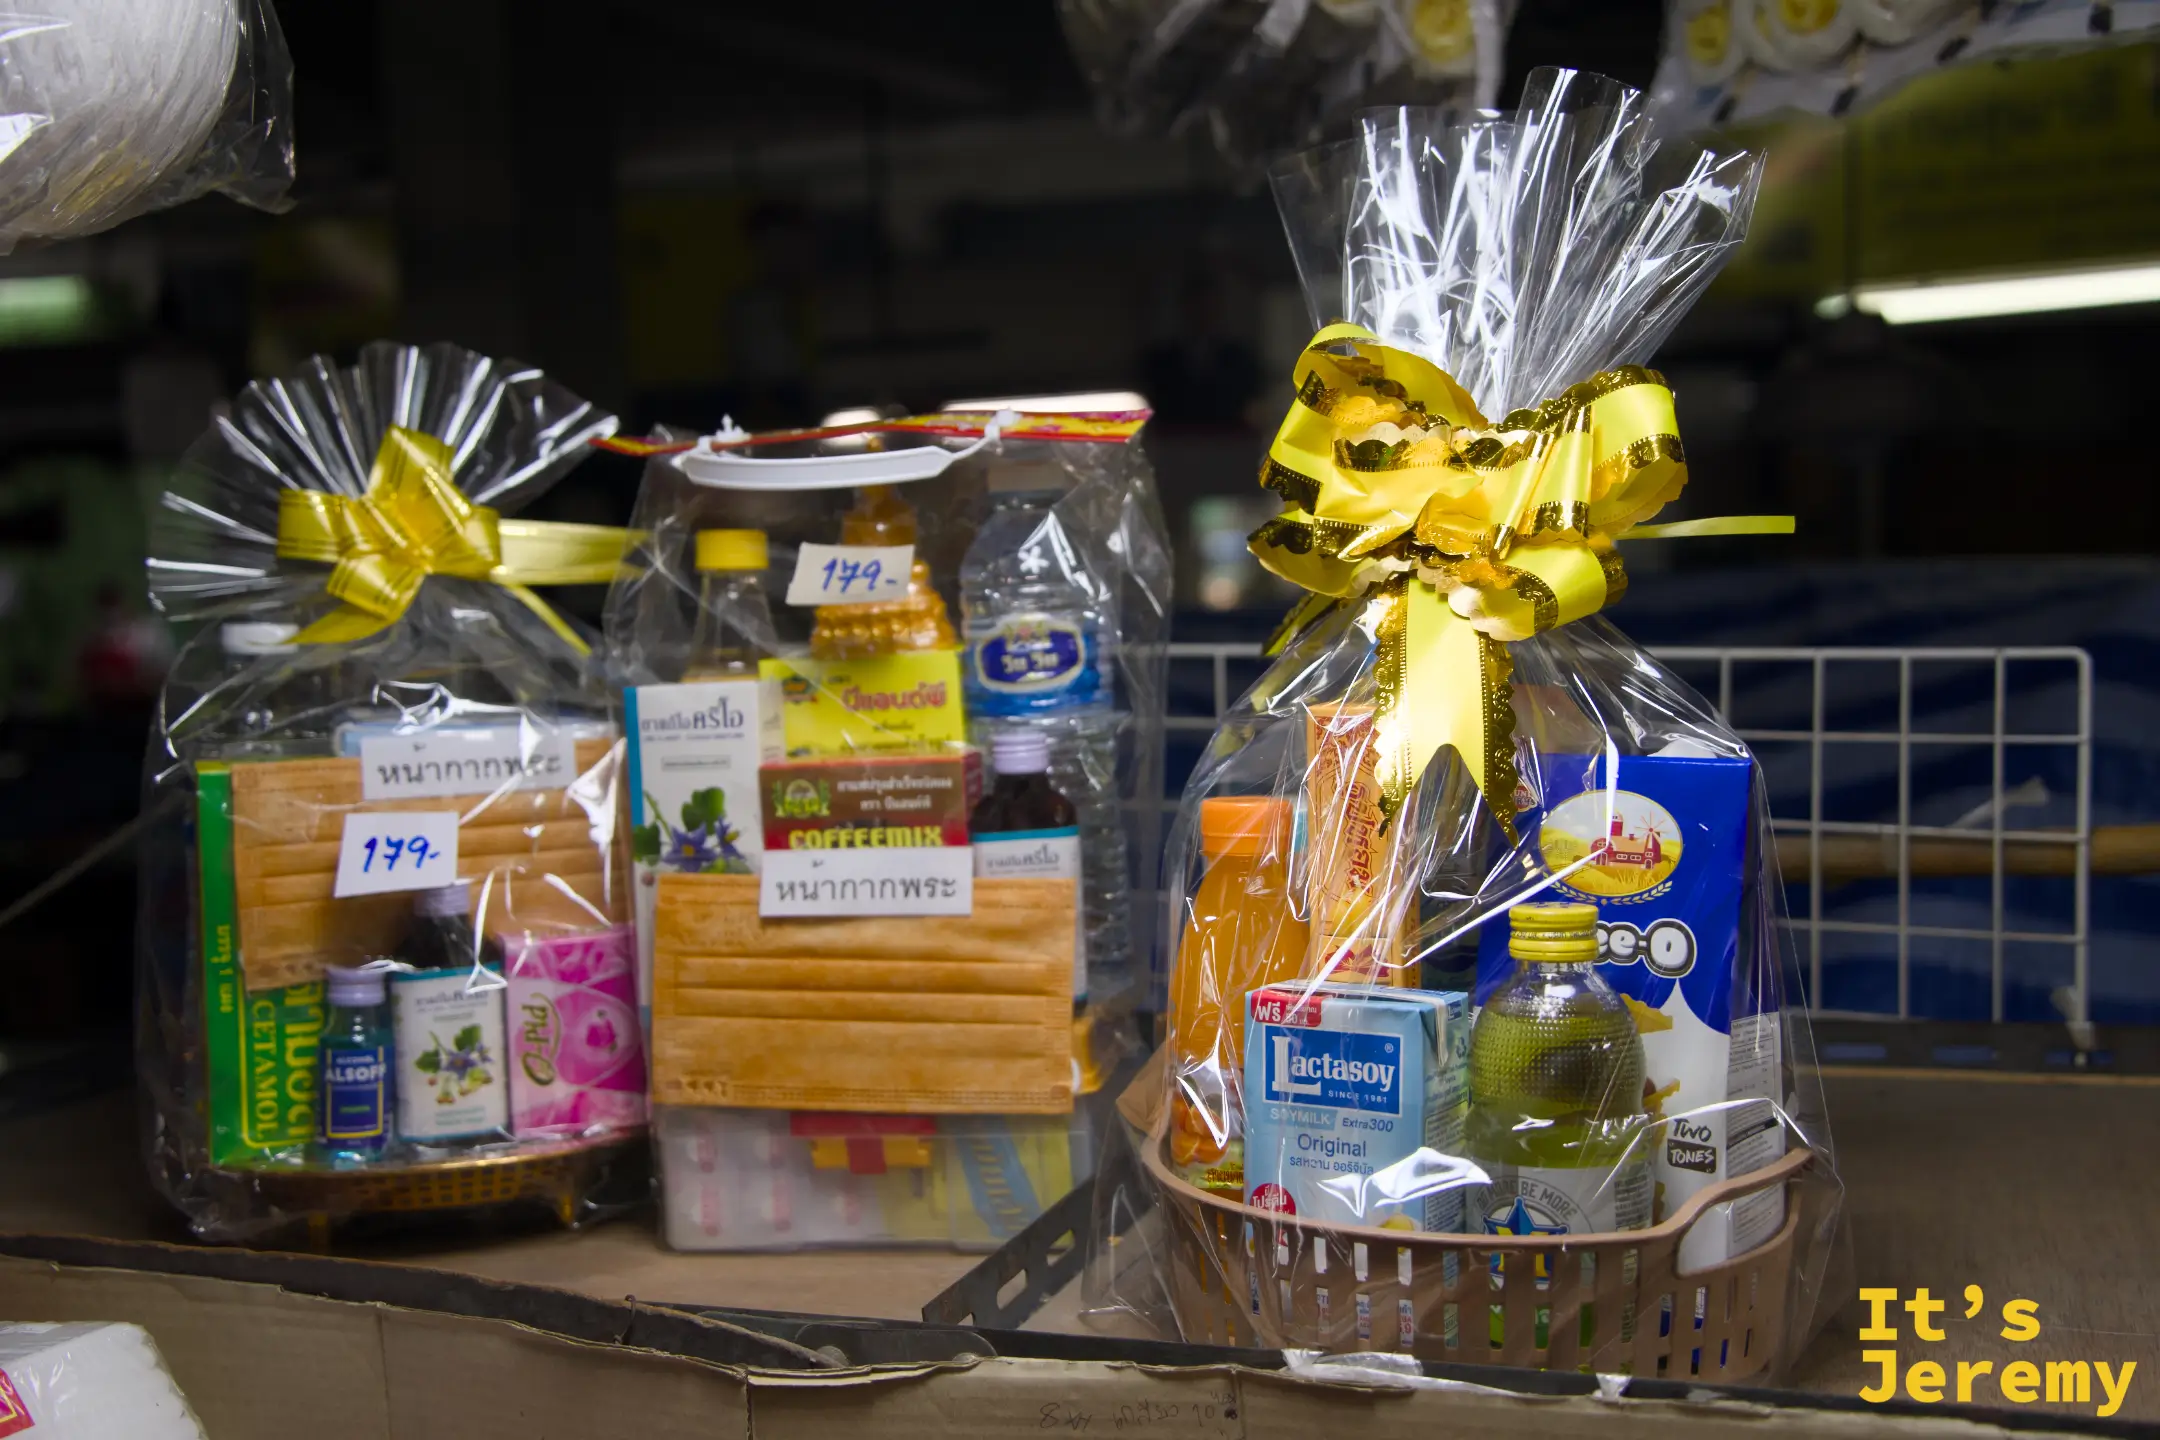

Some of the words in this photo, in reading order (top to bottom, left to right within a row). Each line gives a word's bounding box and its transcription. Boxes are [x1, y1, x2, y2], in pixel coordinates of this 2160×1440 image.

[377, 741, 561, 785] หน้ากากพระ
[775, 858, 957, 902] หน้ากากพระ
[1257, 1002, 1281, 1023] ฟรี
[1272, 1035, 1396, 1097] Lactasoy
[1328, 1090, 1360, 1101] SINCE
[1270, 1108, 1331, 1126] SOYMILK
[1297, 1133, 1367, 1158] Original
[1670, 1149, 1715, 1165] TONES
[1521, 1180, 1539, 1199] BE
[1538, 1187, 1578, 1221] MORE
